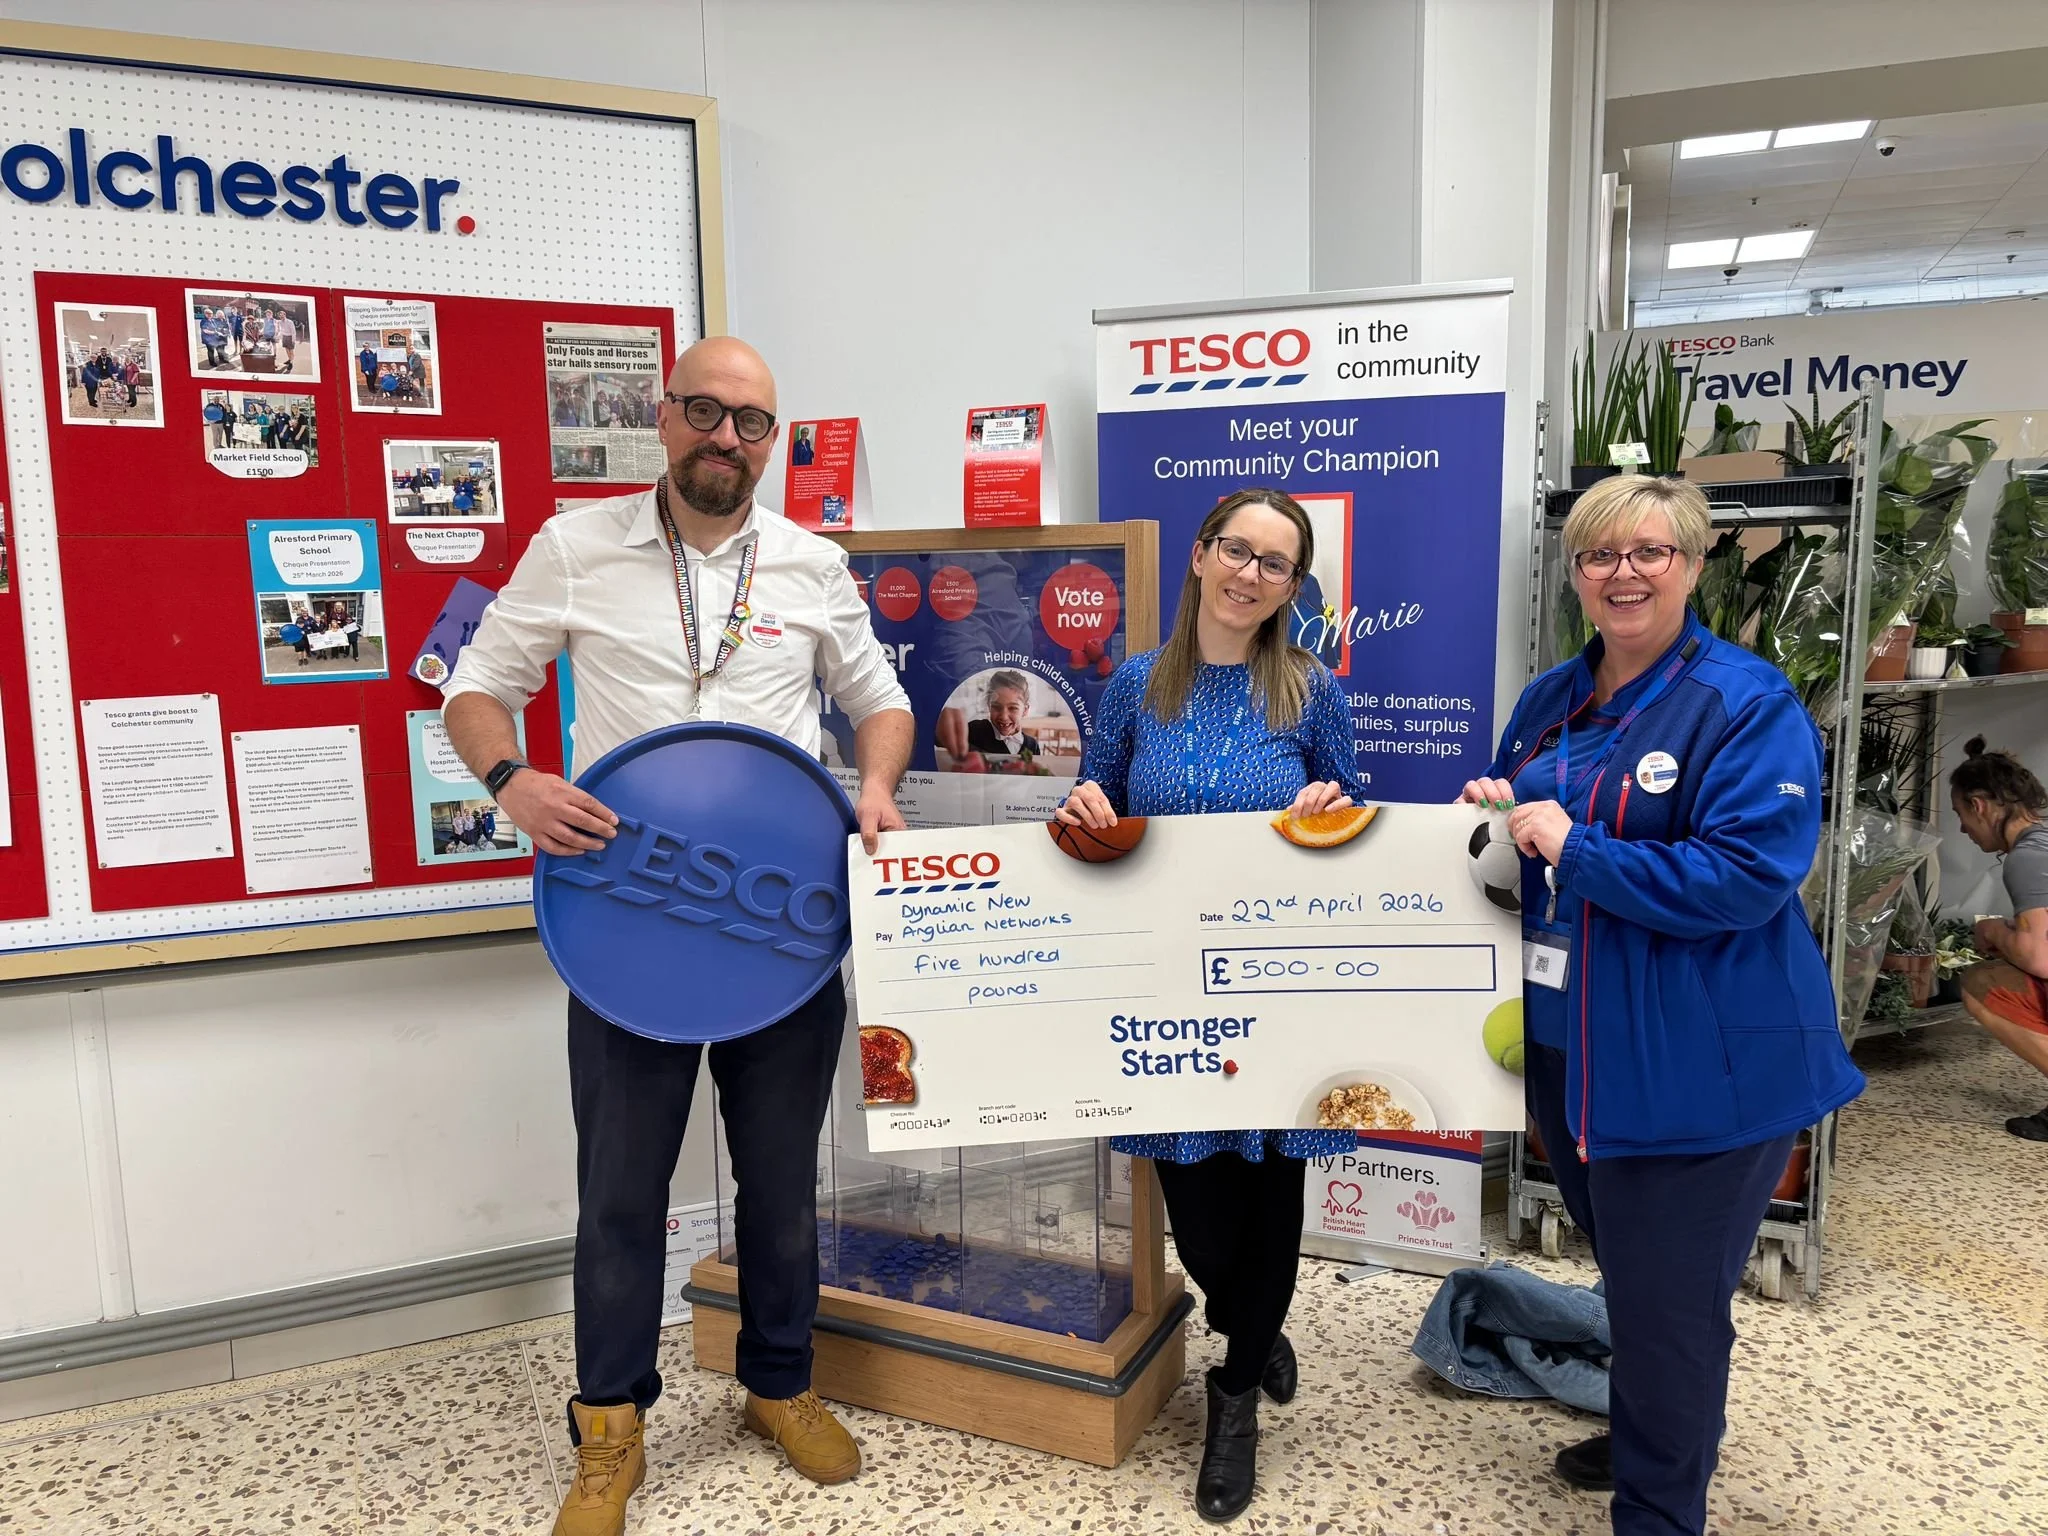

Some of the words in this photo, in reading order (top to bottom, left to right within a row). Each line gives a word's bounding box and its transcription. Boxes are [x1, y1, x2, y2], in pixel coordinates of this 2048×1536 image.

[547, 345, 567, 356] Only
[570, 347, 594, 356] Fools
[597, 348, 613, 357] and
[616, 349, 648, 358] Horses
[1130, 328, 1310, 376] TESCO
[1337, 322, 1359, 345] in
[1368, 319, 1408, 343] the
[1666, 336, 1736, 353] TESCO
[1741, 334, 1774, 348] Bank
[570, 359, 592, 368] hails
[594, 361, 630, 371] sensory
[633, 362, 656, 370] room
[1337, 352, 1480, 379] community
[1672, 359, 1792, 402] Travel
[1808, 355, 1968, 396] Money
[1230, 418, 1291, 442] Meet
[1300, 417, 1358, 443] your
[214, 453, 246, 462] Market
[249, 453, 270, 462] Field
[272, 454, 302, 463] School
[1154, 452, 1294, 481] Community
[1303, 445, 1439, 476] Champion
[246, 468, 273, 476] £1500
[274, 534, 315, 543] Alresford
[318, 533, 352, 544] Primary
[444, 531, 479, 540] Chapter
[300, 547, 331, 555] School
[672, 542, 686, 576] USDAW
[743, 546, 755, 578] USDAW
[678, 576, 691, 606] UNION
[1054, 587, 1104, 606] Vote
[683, 609, 693, 625] MY
[1057, 612, 1102, 628] now
[686, 626, 695, 638] IN
[1297, 602, 1424, 654] Marie
[689, 639, 698, 670] PRIDE
[884, 643, 915, 672] er
[984, 650, 1029, 667] Helping
[1031, 660, 1074, 694] children
[1072, 694, 1093, 736] thrive
[1246, 676, 1255, 694] STAFF
[1346, 695, 1379, 708] able
[1384, 694, 1476, 713] donations,
[112, 720, 151, 728] Colchester
[1233, 706, 1244, 725] STAFF
[1351, 715, 1397, 733] nities,
[1404, 716, 1470, 737] surplus
[1222, 737, 1232, 756] STAFF
[1354, 738, 1462, 759] partnerships
[920, 778, 935, 786] you.
[1209, 768, 1220, 788] STAFF
[1777, 783, 1805, 794] TESCO
[873, 852, 1000, 882] TESCO
[901, 902, 976, 923] Dynamic
[988, 894, 1030, 910] New
[1308, 893, 1363, 919] April
[1379, 892, 1444, 913] 2026
[1200, 913, 1223, 922] Date
[876, 932, 893, 942] Pay
[902, 921, 974, 942] Anglian
[914, 954, 961, 974] five
[979, 949, 1059, 968] hundred
[1211, 957, 1231, 985] £
[968, 982, 1038, 1004] pounds
[1110, 1015, 1256, 1046] Stronger
[1342, 1156, 1440, 1186] Partners.
[1323, 1216, 1345, 1225] British
[1346, 1219, 1366, 1228] Heart
[1323, 1224, 1366, 1235] Foundation
[1398, 1234, 1430, 1246] Prince's
[1431, 1240, 1452, 1249] Trust
